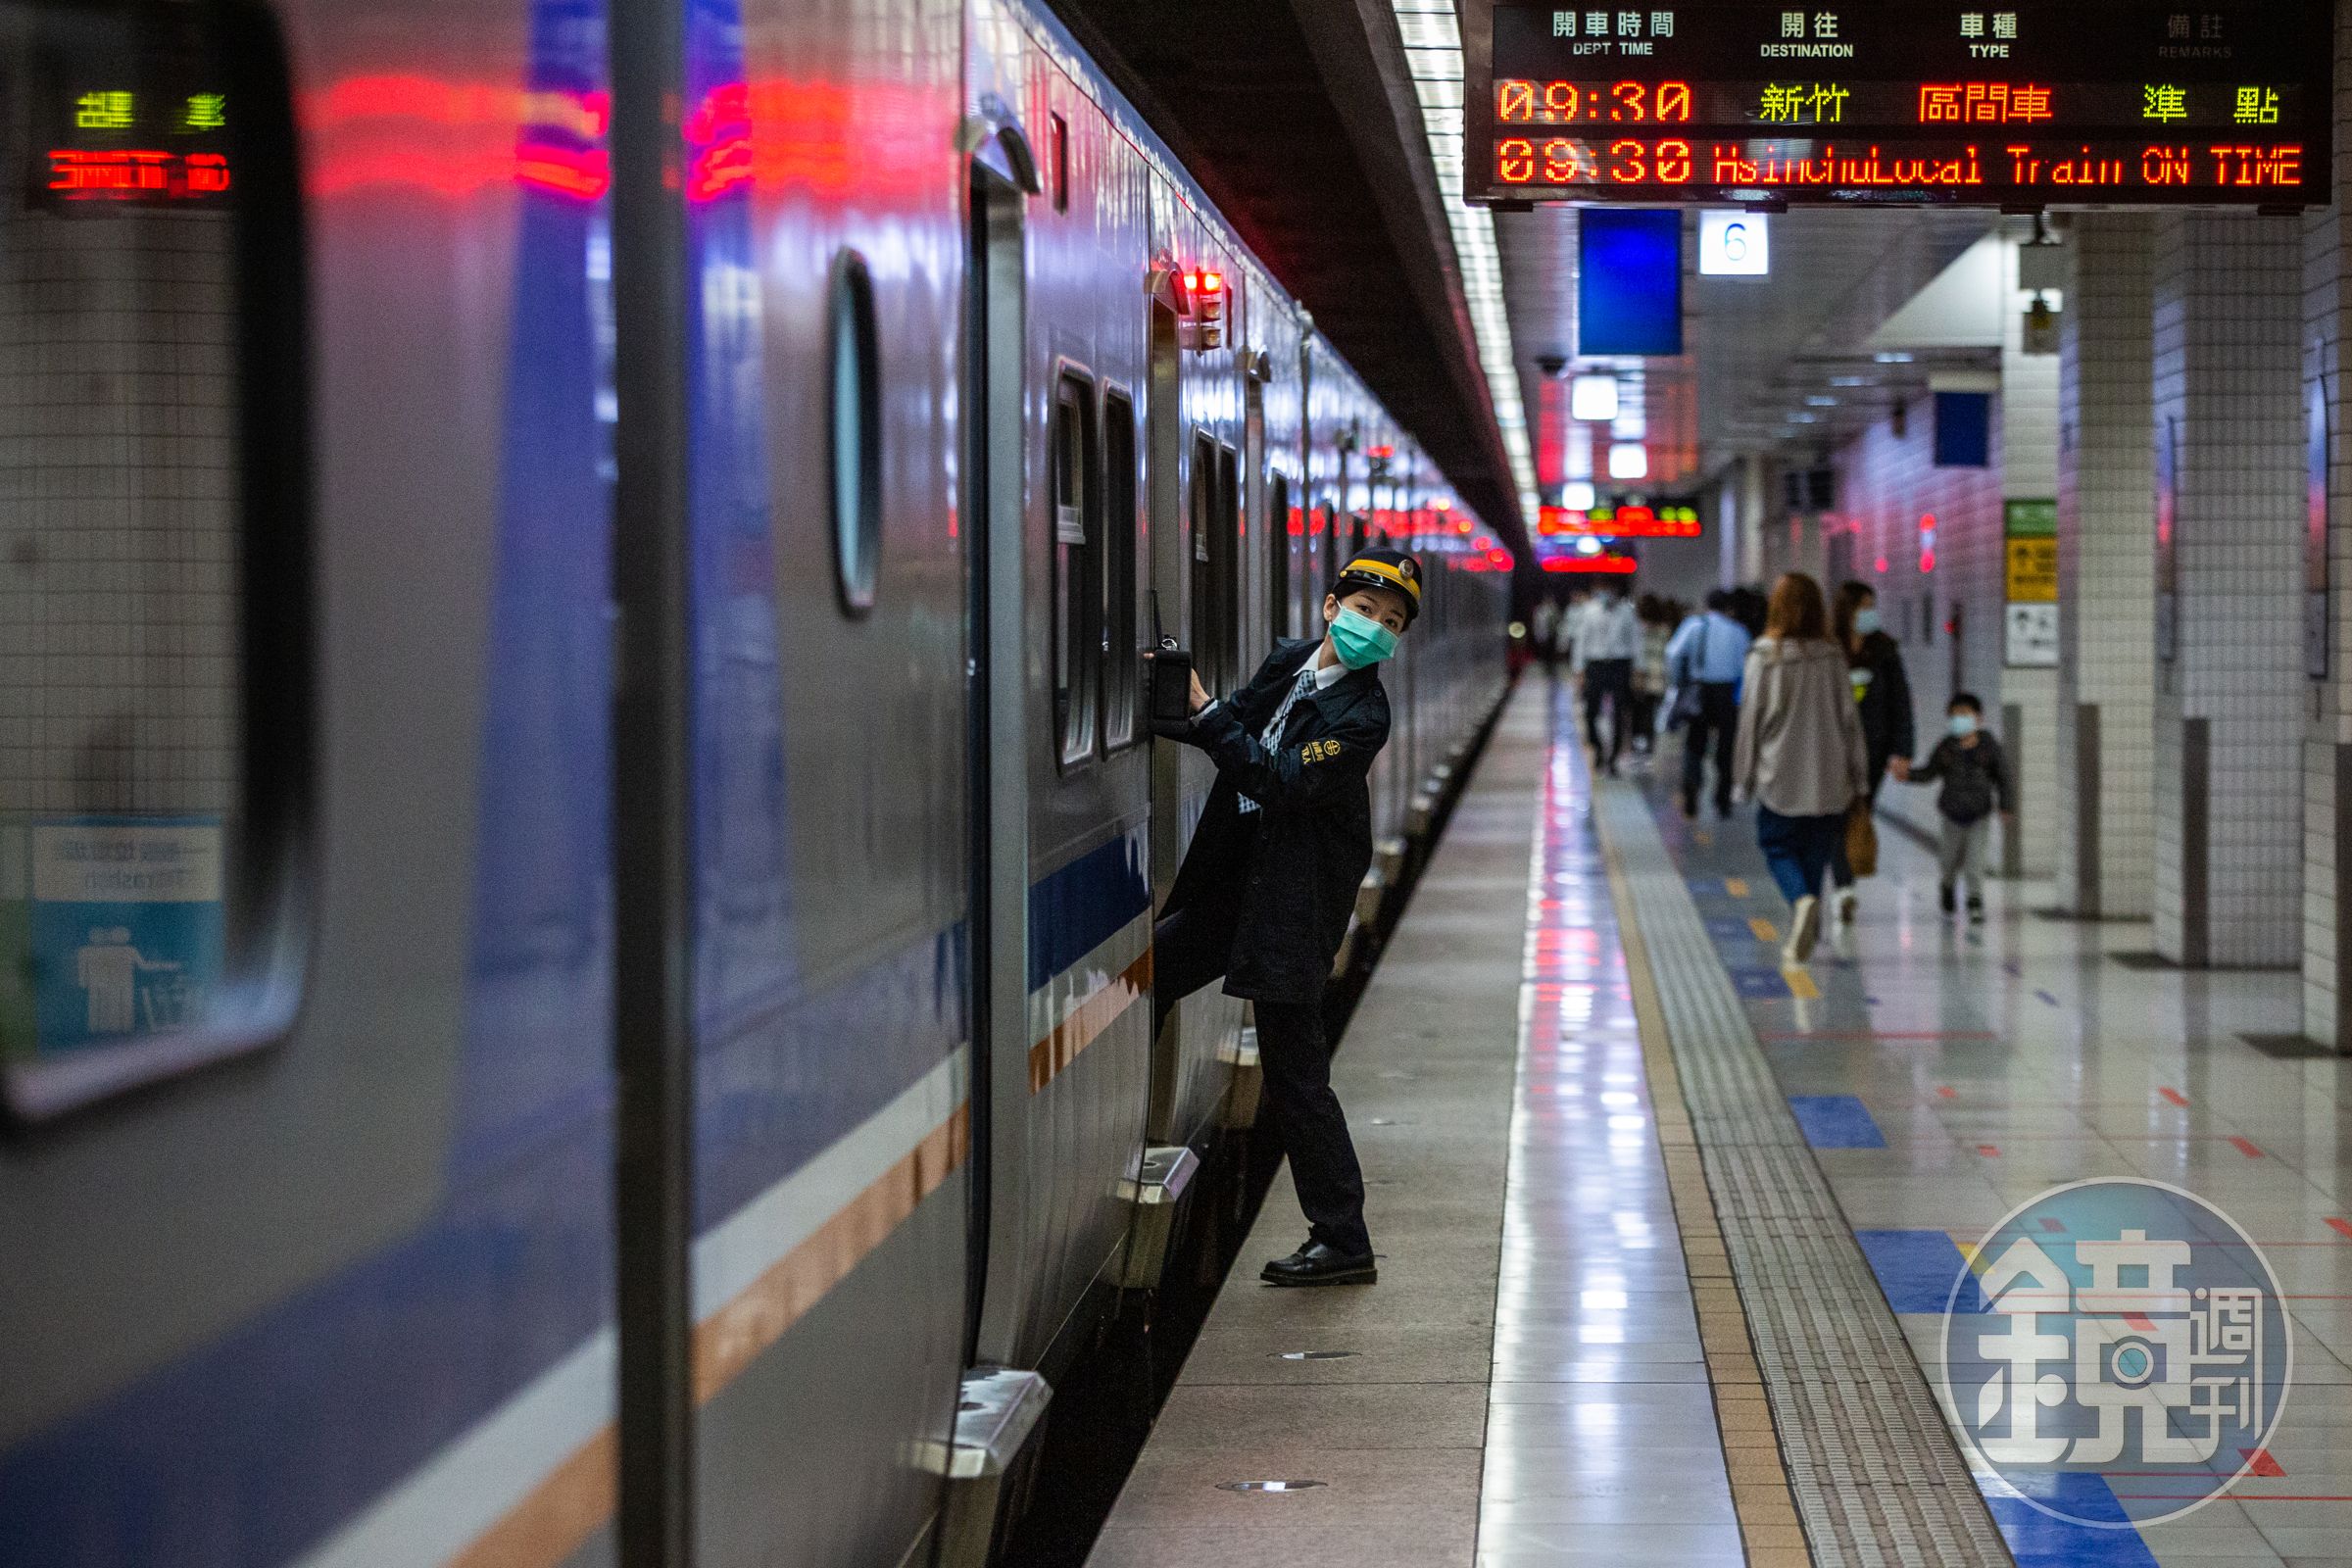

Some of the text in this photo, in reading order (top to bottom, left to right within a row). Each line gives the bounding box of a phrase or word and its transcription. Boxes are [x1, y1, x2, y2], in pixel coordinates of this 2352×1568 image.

[1552, 12, 1674, 37] 開車時間
[1781, 12, 1838, 38] 開往
[1960, 12, 2018, 39] 車種
[2167, 13, 2224, 39] 備註
[1573, 42, 1653, 56] DEPT TIME
[1760, 44, 1853, 58] DESTINATION
[1969, 44, 2009, 58] TYPE
[2158, 46, 2232, 58] REMARKS
[1498, 80, 1690, 122] 09:30
[1760, 83, 1850, 122] 新竹
[1919, 82, 2053, 123] 區間車
[1498, 137, 1690, 183] 09:30
[2006, 144, 2123, 184] Train
[2142, 146, 2188, 184] ON
[2210, 144, 2303, 185] TIME
[1725, 222, 1746, 261] 6
